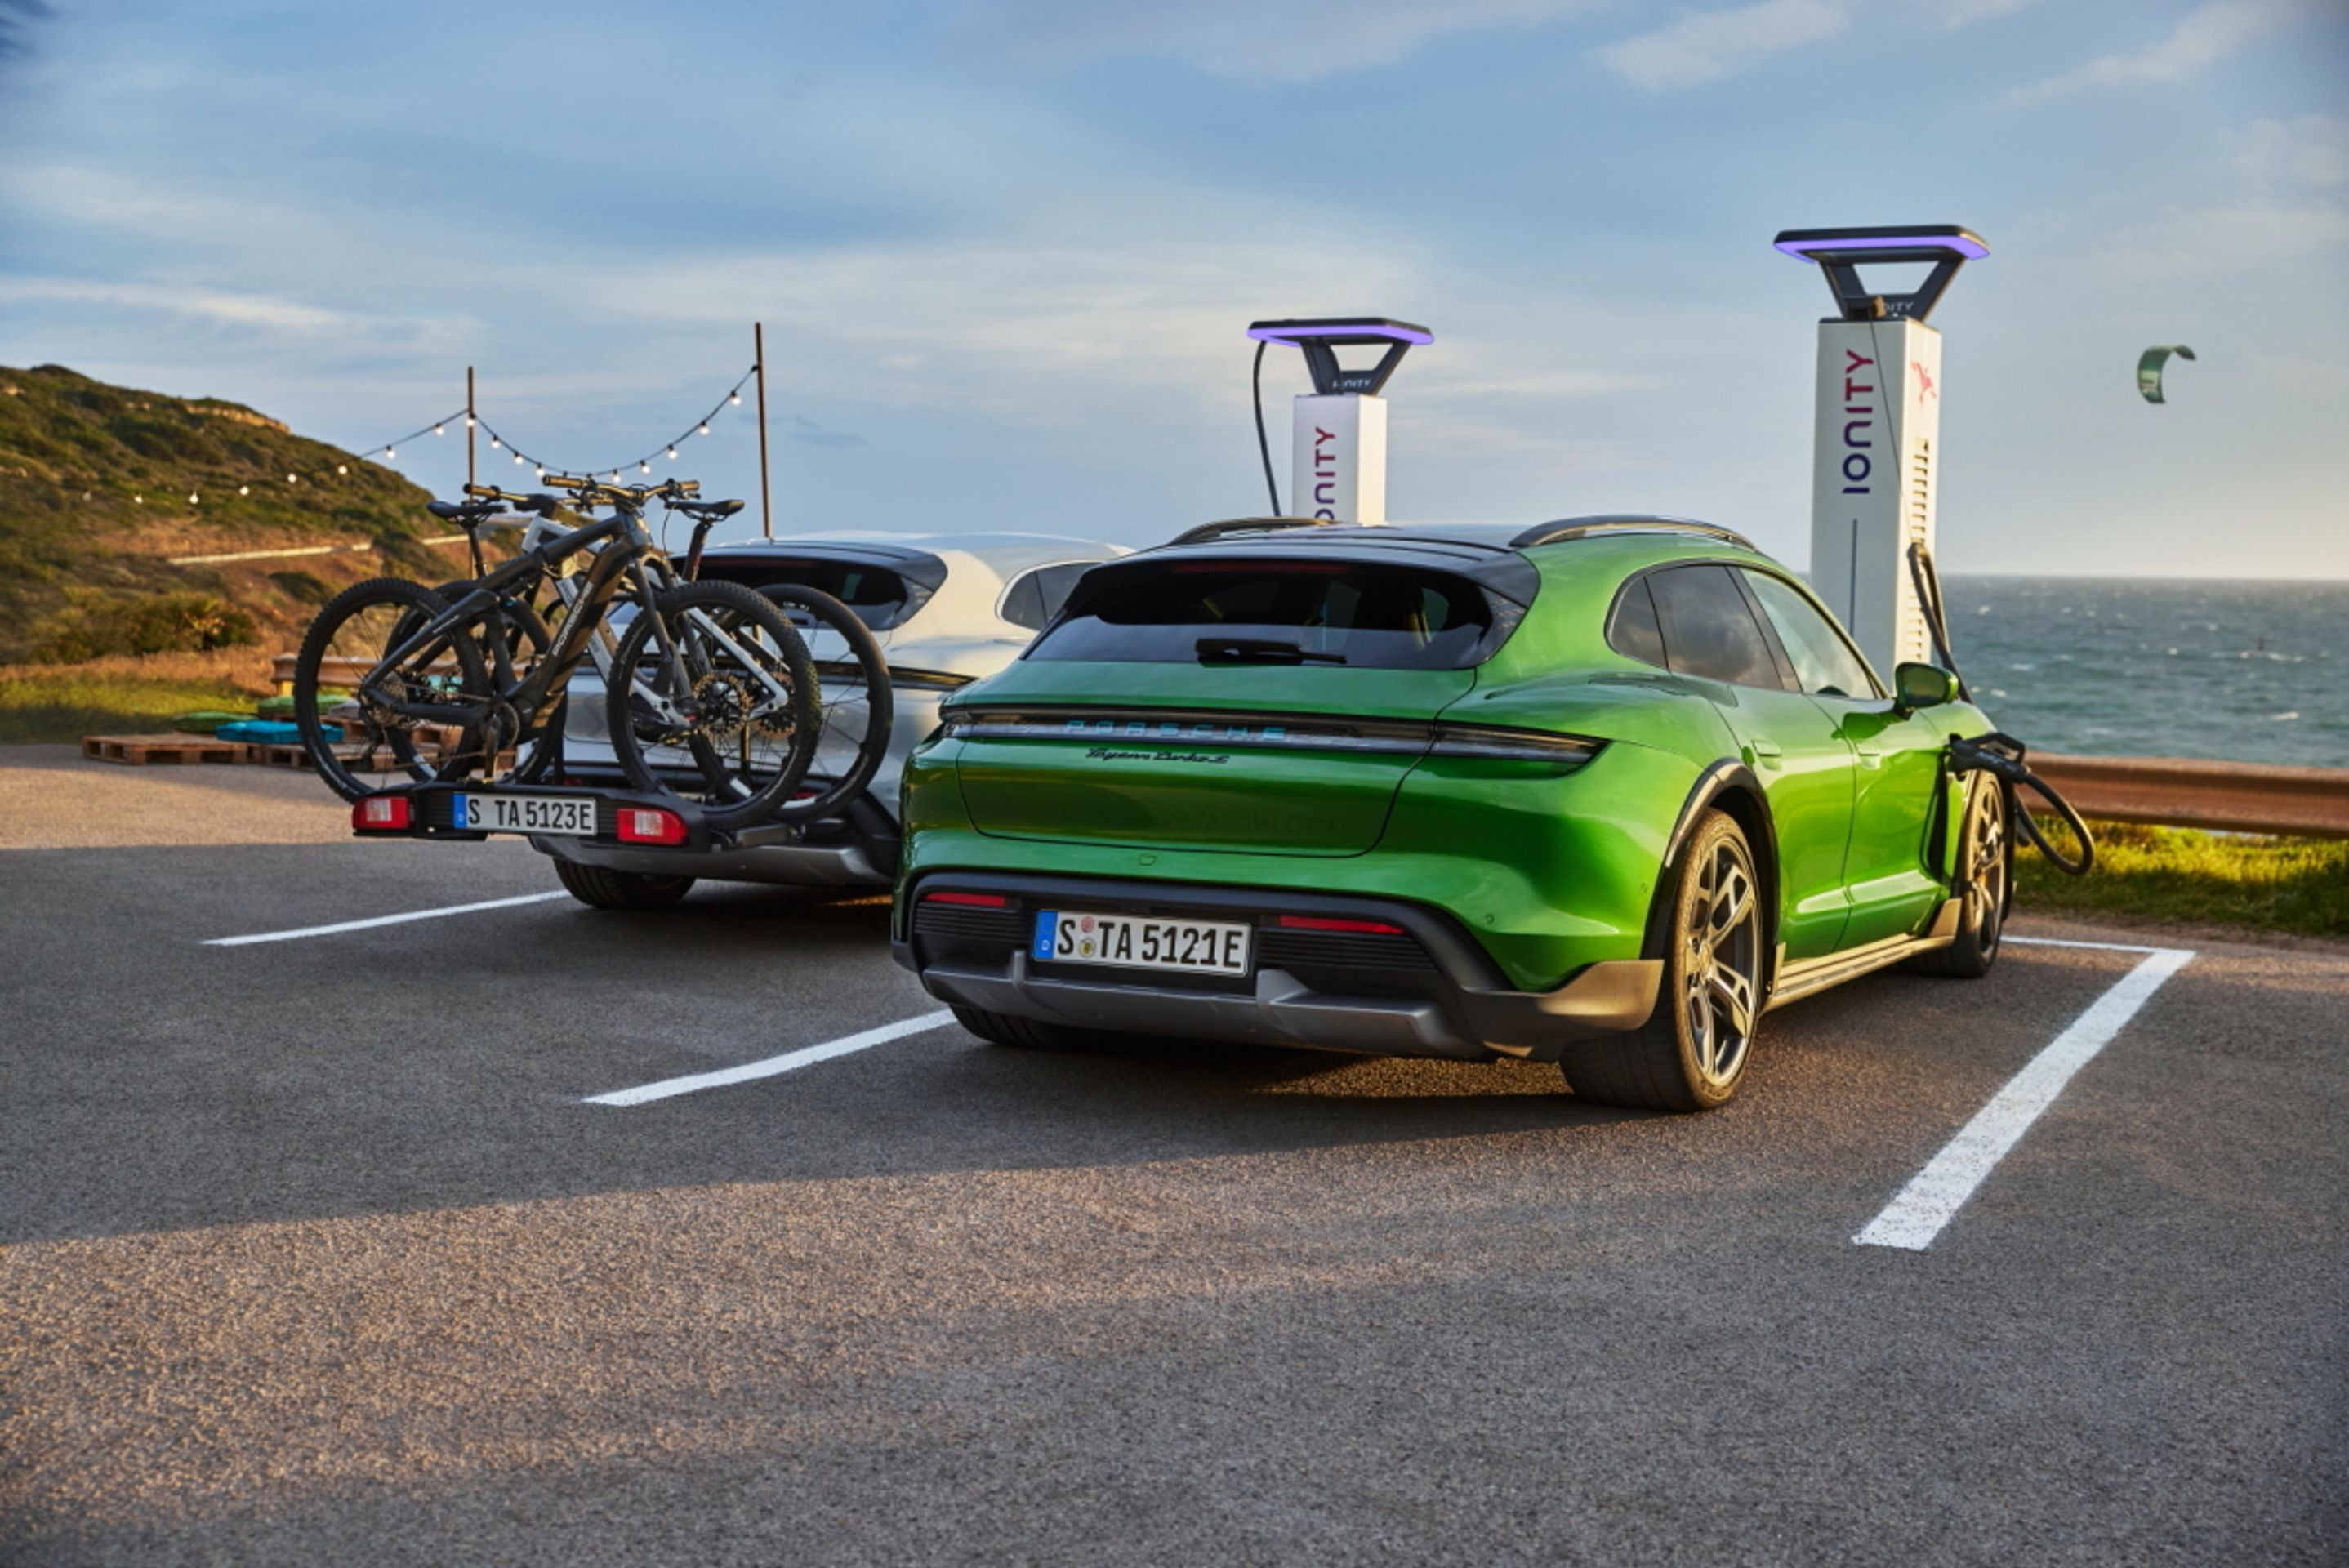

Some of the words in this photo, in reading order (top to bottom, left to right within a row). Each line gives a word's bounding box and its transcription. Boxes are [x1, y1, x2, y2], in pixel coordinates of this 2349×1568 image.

[1841, 349, 1874, 494] IONITY
[1067, 719, 1286, 740] PORSCHE
[468, 798, 481, 825] S
[494, 800, 520, 827] TA
[526, 800, 592, 831] 5123E
[1057, 920, 1076, 955] S
[1098, 922, 1132, 960] TA
[1141, 924, 1243, 968] 5121E
